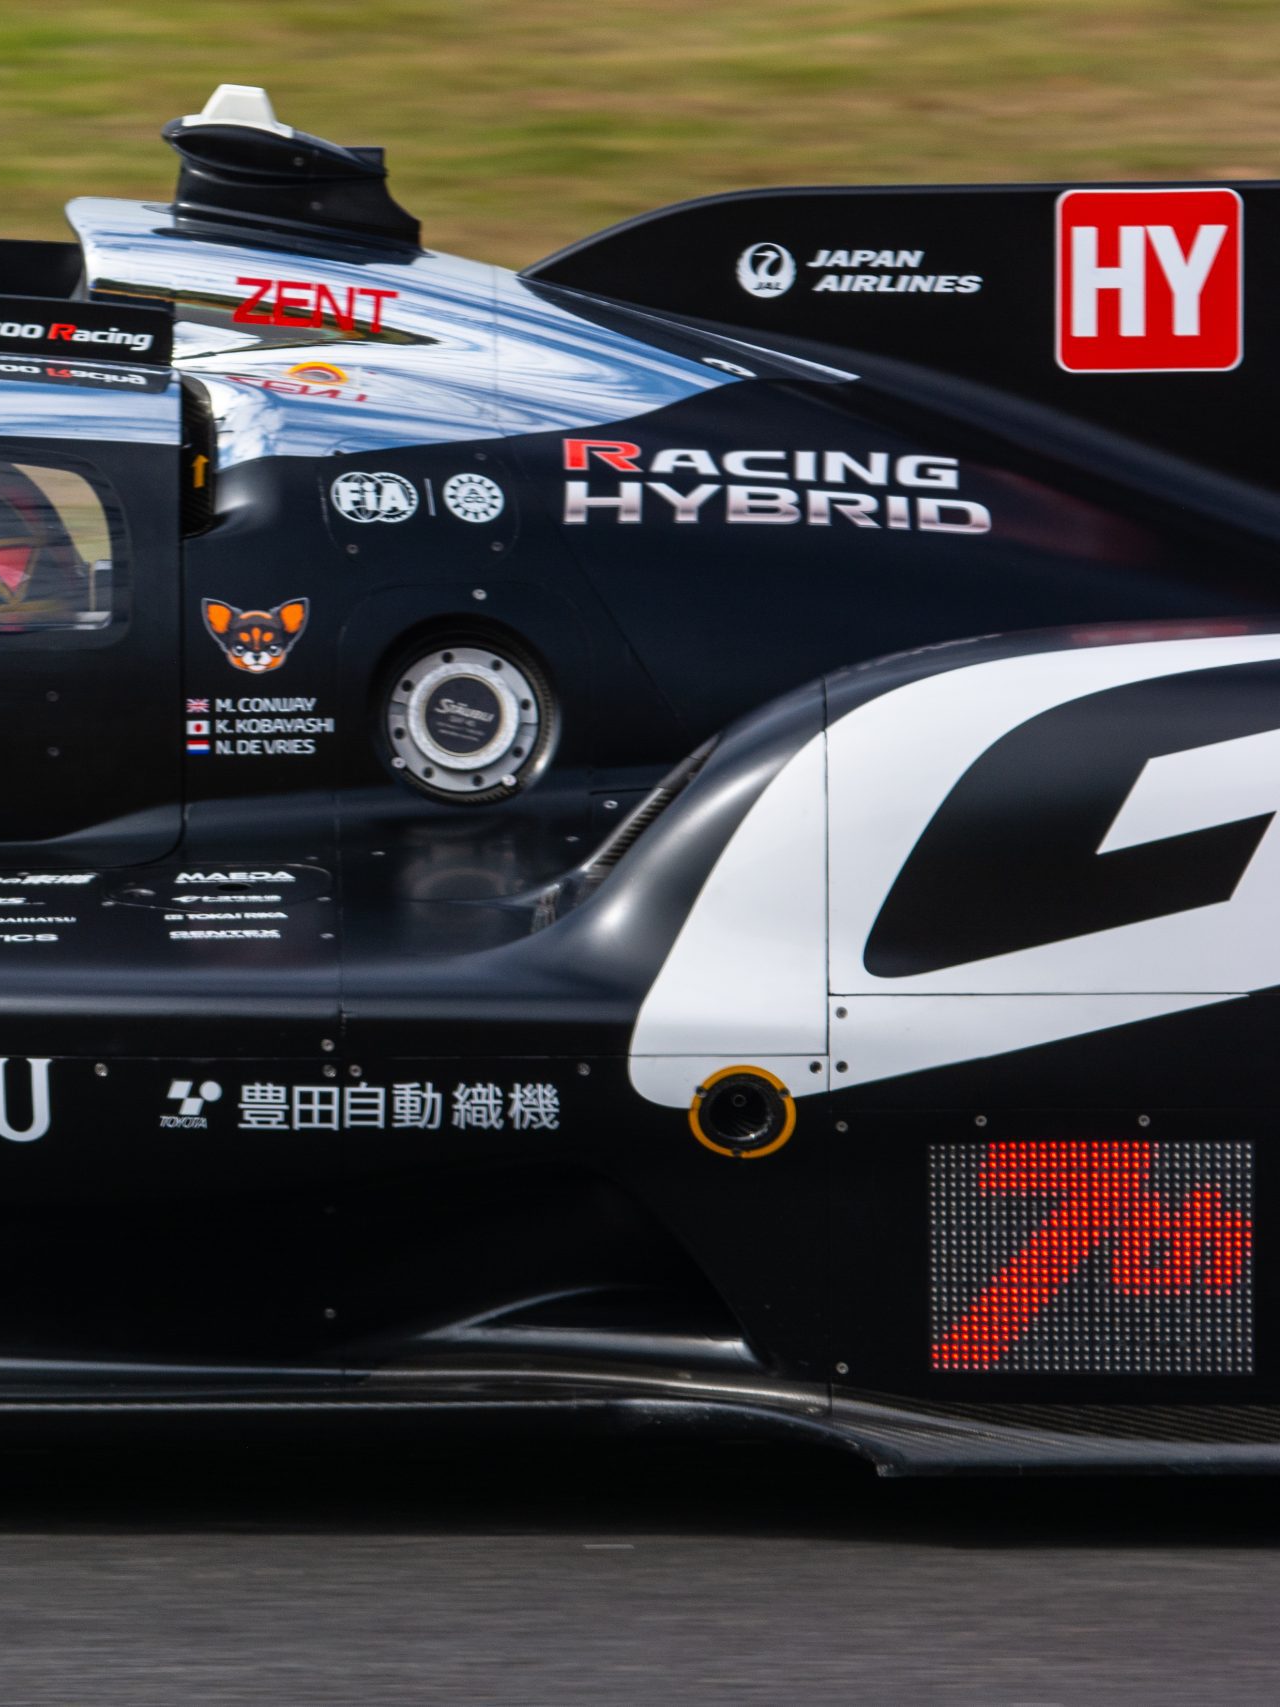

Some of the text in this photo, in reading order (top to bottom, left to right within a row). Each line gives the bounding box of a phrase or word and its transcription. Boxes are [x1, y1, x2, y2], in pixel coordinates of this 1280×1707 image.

[807, 249, 924, 269] JAPAN
[812, 274, 984, 294] AIRLINES
[1070, 225, 1229, 338] HY
[233, 277, 399, 333] ZENT
[47, 322, 153, 352] Racing
[563, 437, 960, 489] RACING
[563, 481, 993, 535] HYBRID
[214, 697, 316, 713] M. CONWAY
[214, 717, 336, 734] K. KOBAYASHI
[214, 738, 316, 755] N. DE VRIES
[175, 871, 297, 881] MAEDA
[237, 1082, 561, 1131] 豊田自動織機
[159, 1115, 208, 1129] TOYOTA
